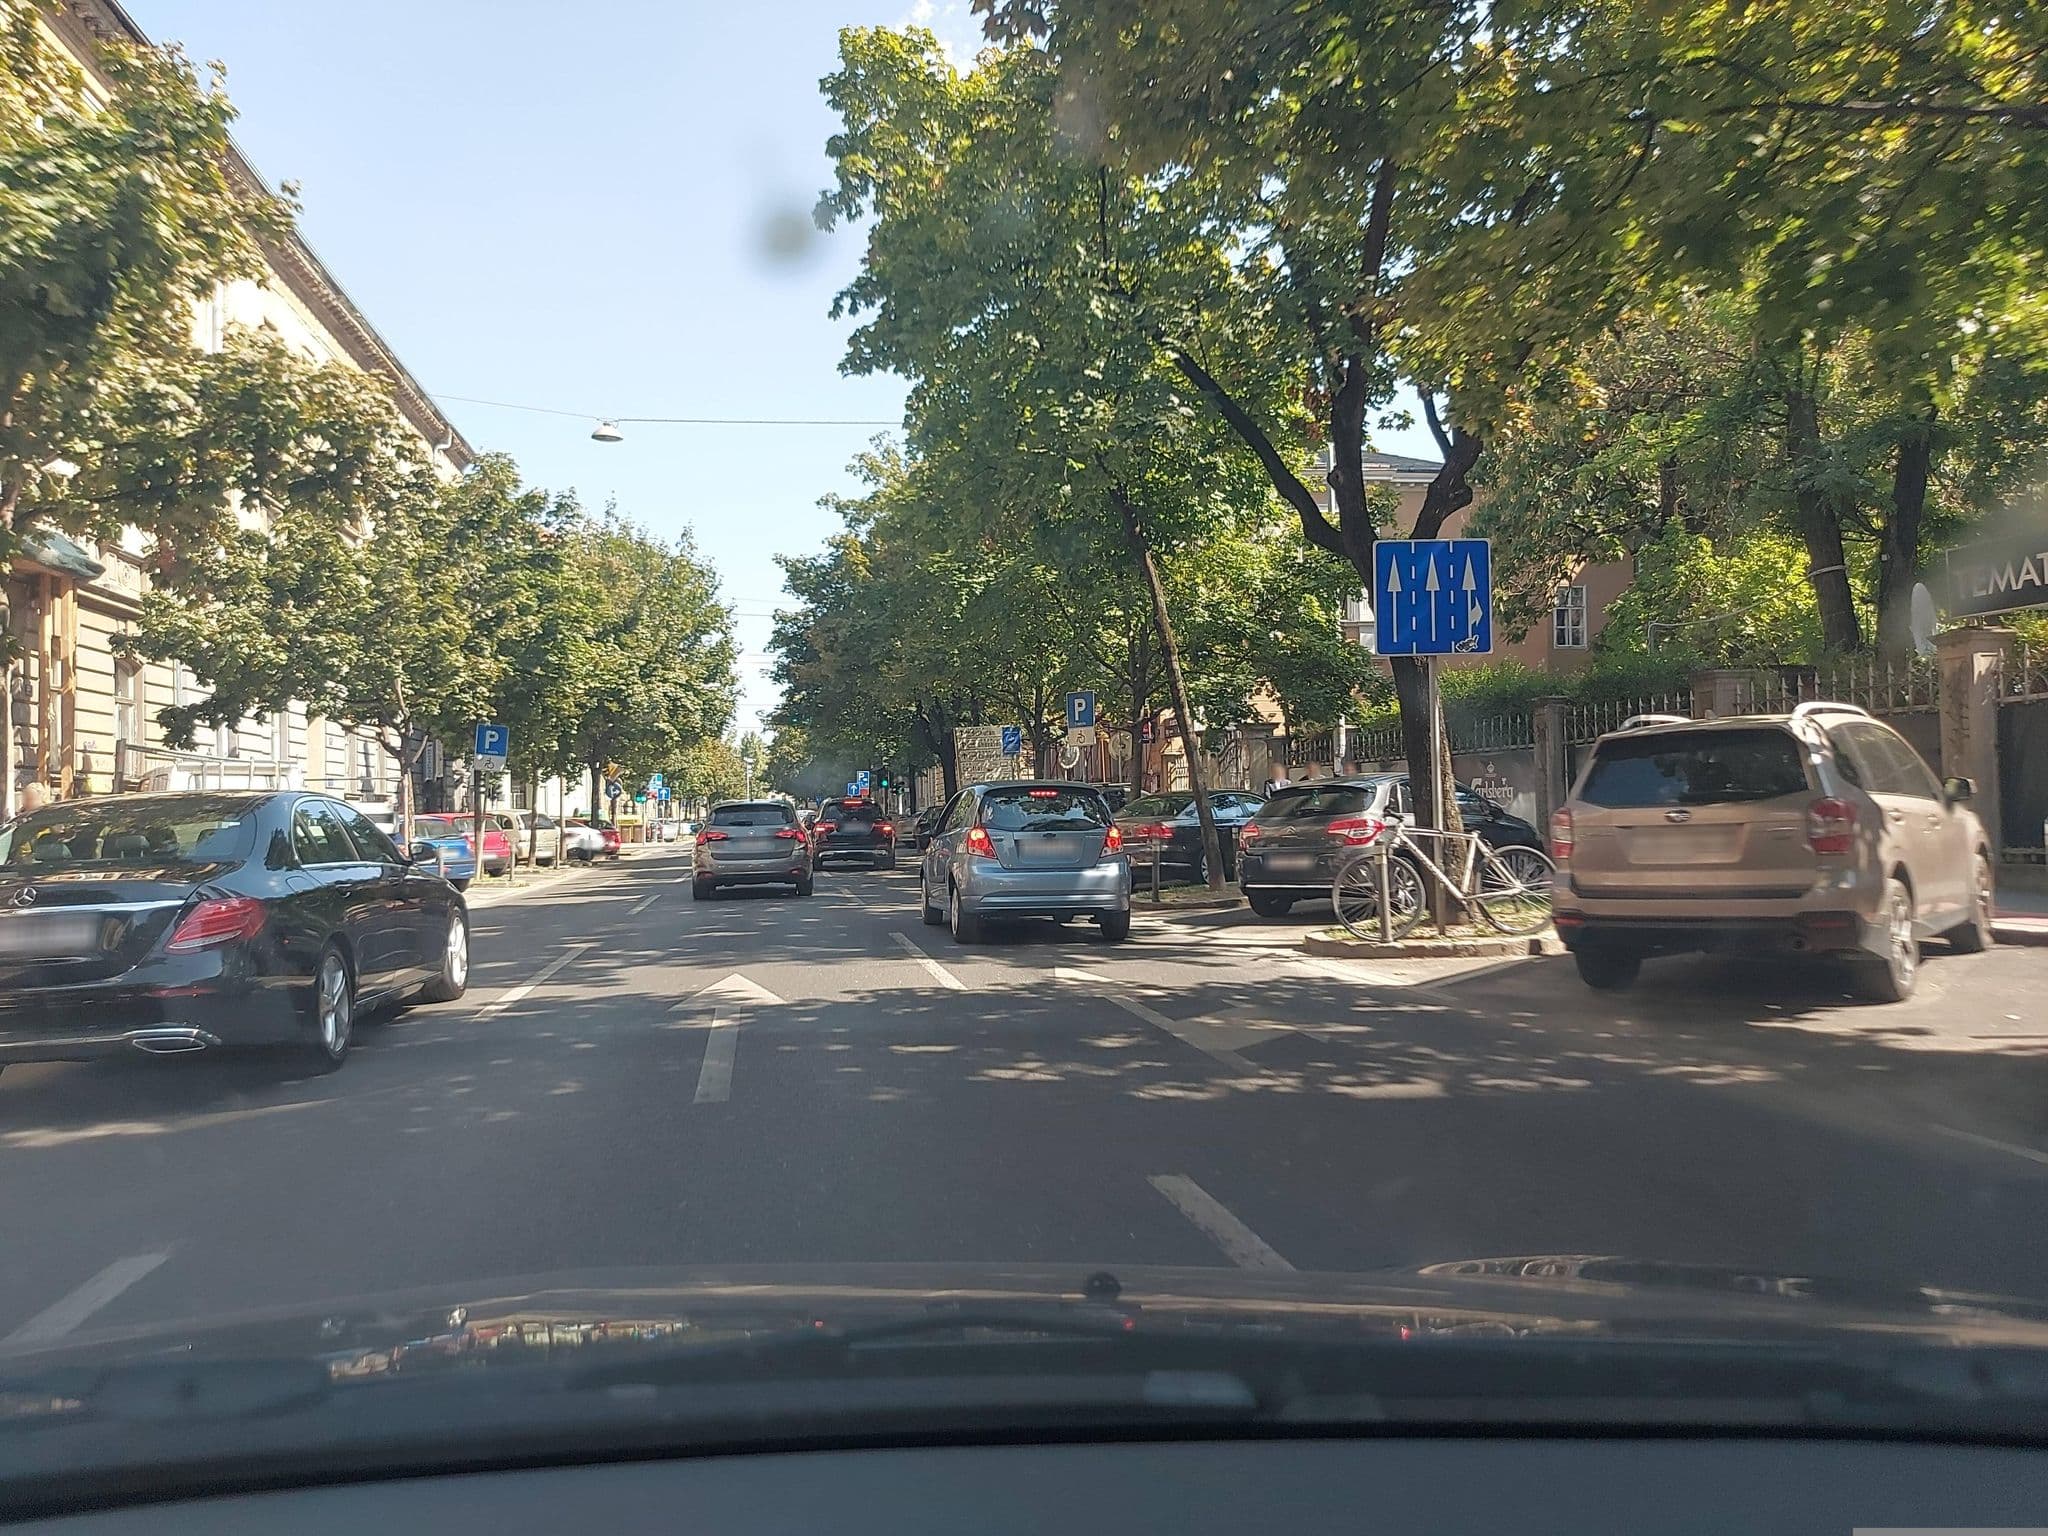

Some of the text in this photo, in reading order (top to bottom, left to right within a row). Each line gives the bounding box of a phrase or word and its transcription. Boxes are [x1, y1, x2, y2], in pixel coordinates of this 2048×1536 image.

[1074, 698, 1086, 721] P
[485, 730, 499, 749] P
[1471, 777, 1514, 803] Carlsberg
